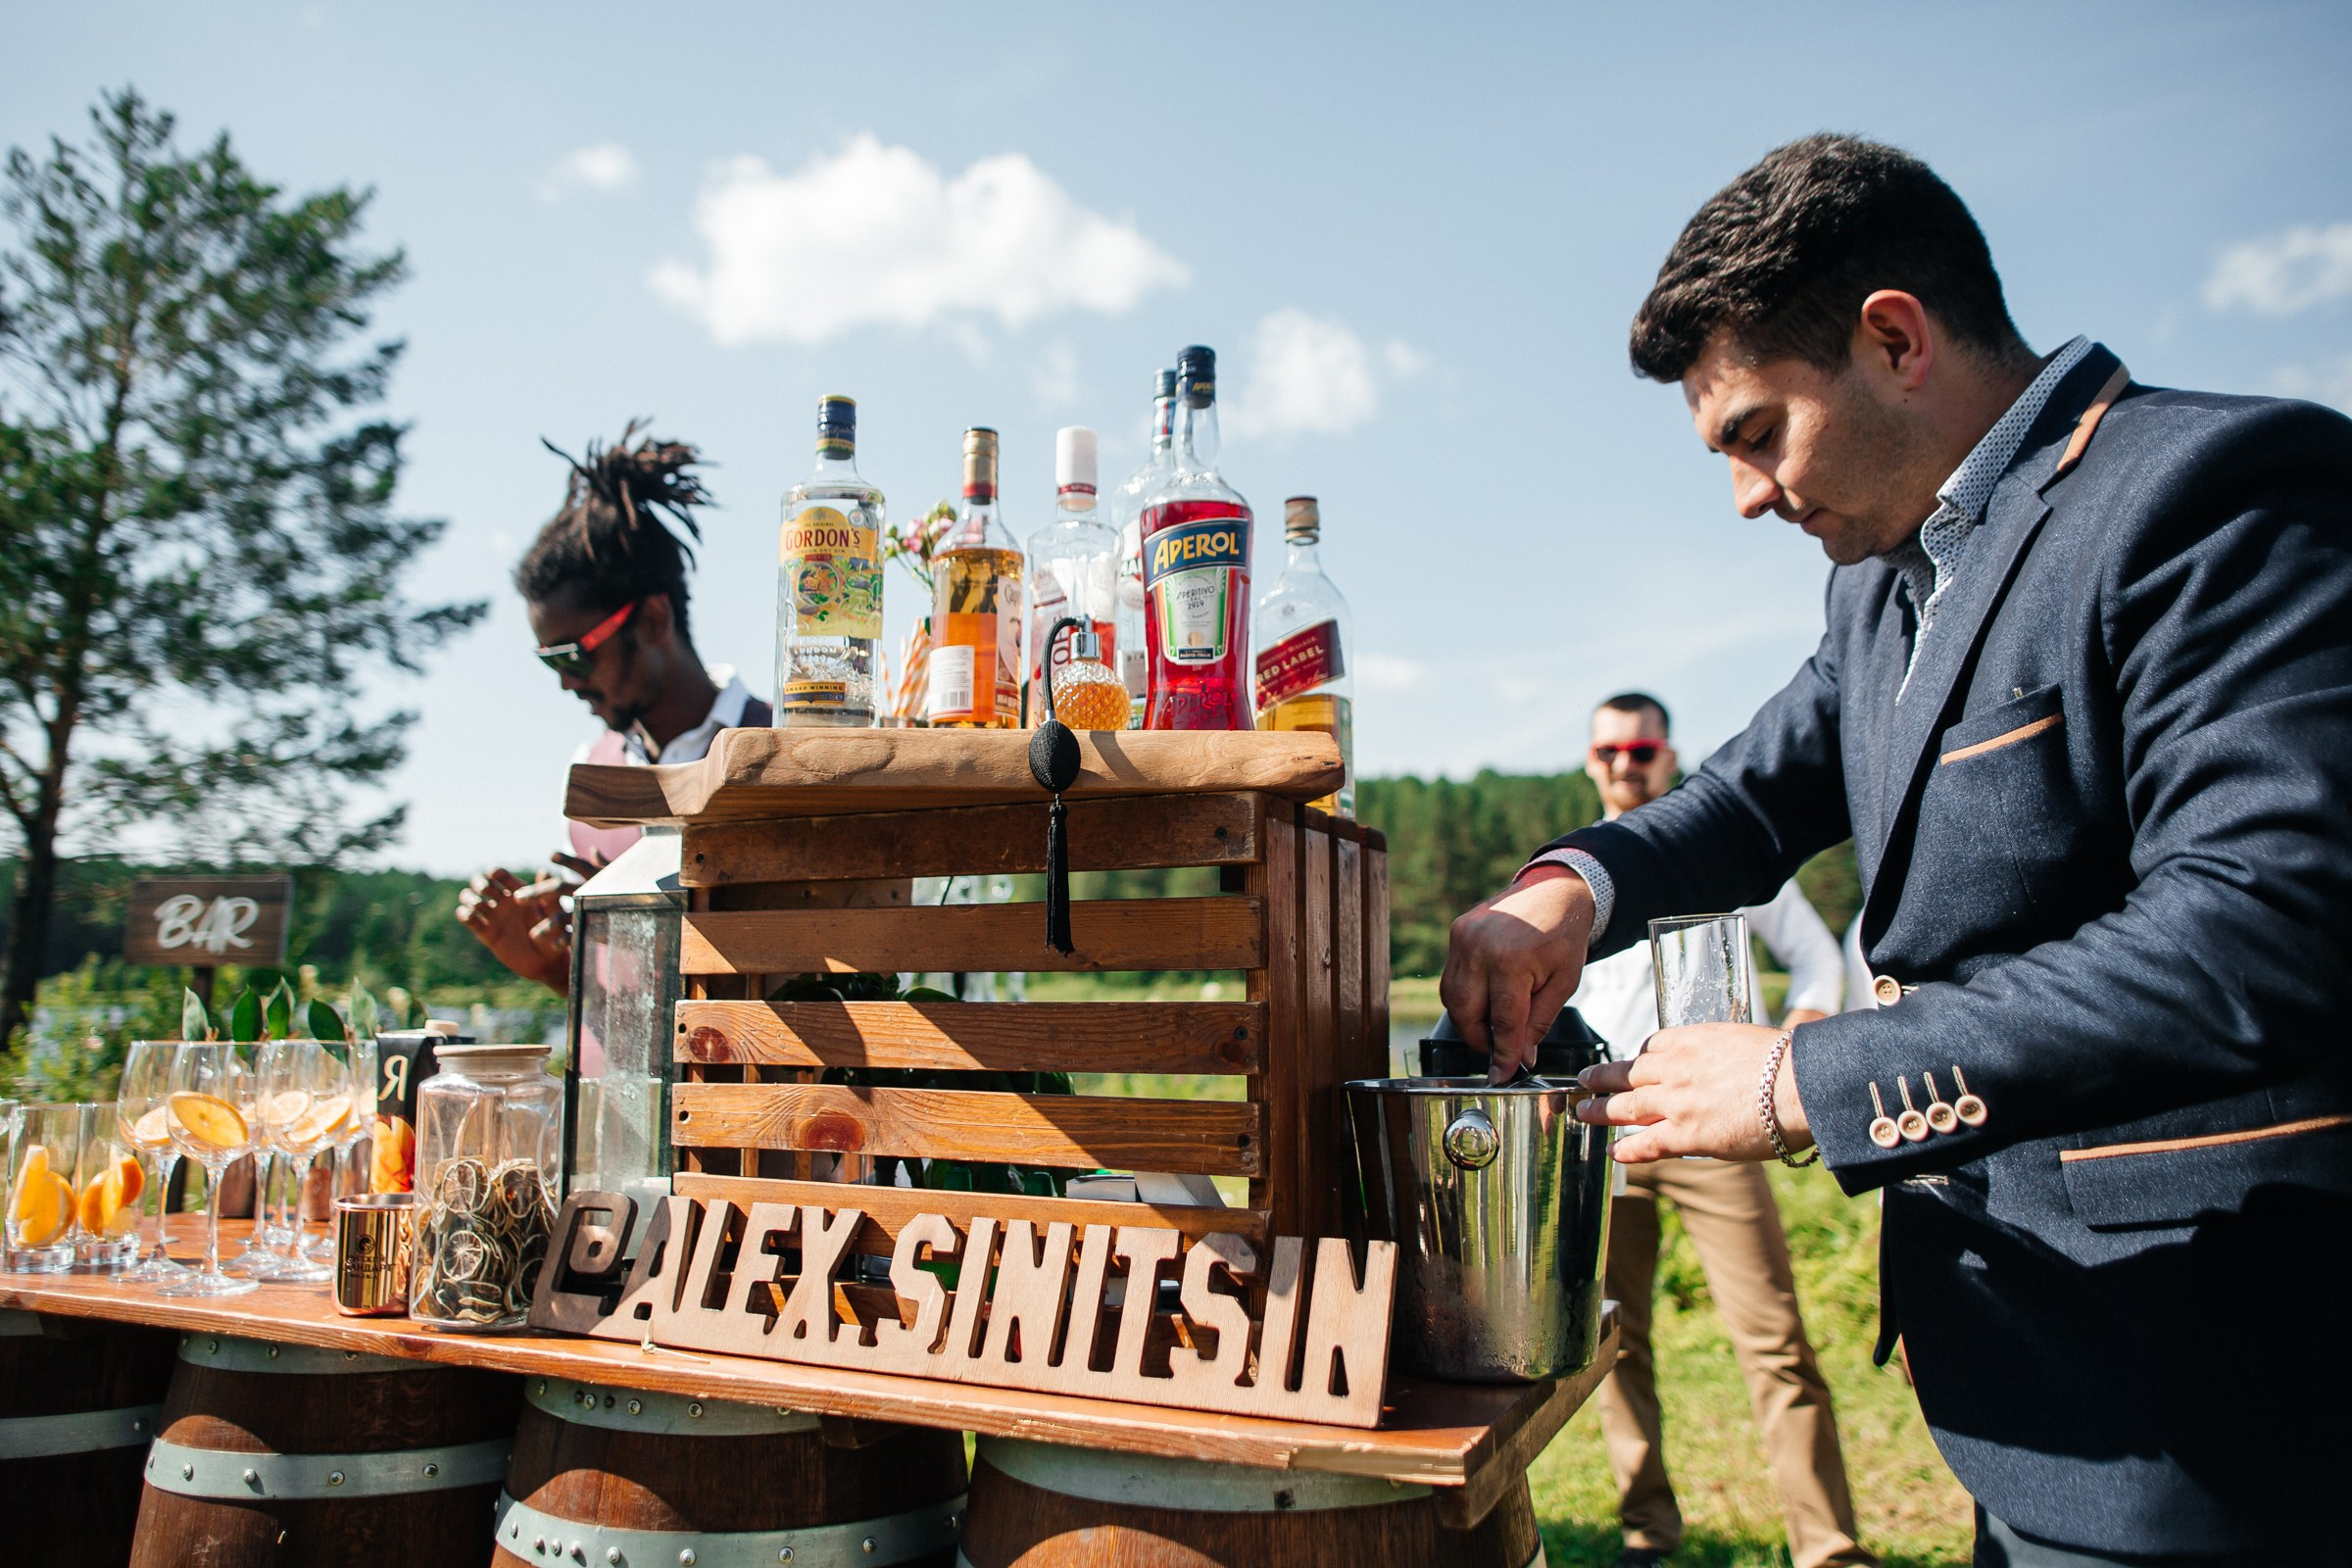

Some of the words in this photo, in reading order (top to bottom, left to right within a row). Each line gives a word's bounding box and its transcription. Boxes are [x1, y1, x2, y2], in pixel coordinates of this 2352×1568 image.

[785, 528, 860, 550] GORDON'S
[1153, 531, 1240, 575] APEROL
[1176, 585, 1215, 601] APERITIVO
[1188, 599, 1204, 610] 1919
[1256, 664, 1280, 683] RED
[1282, 645, 1324, 670] LABEL
[153, 893, 261, 955] BAR
